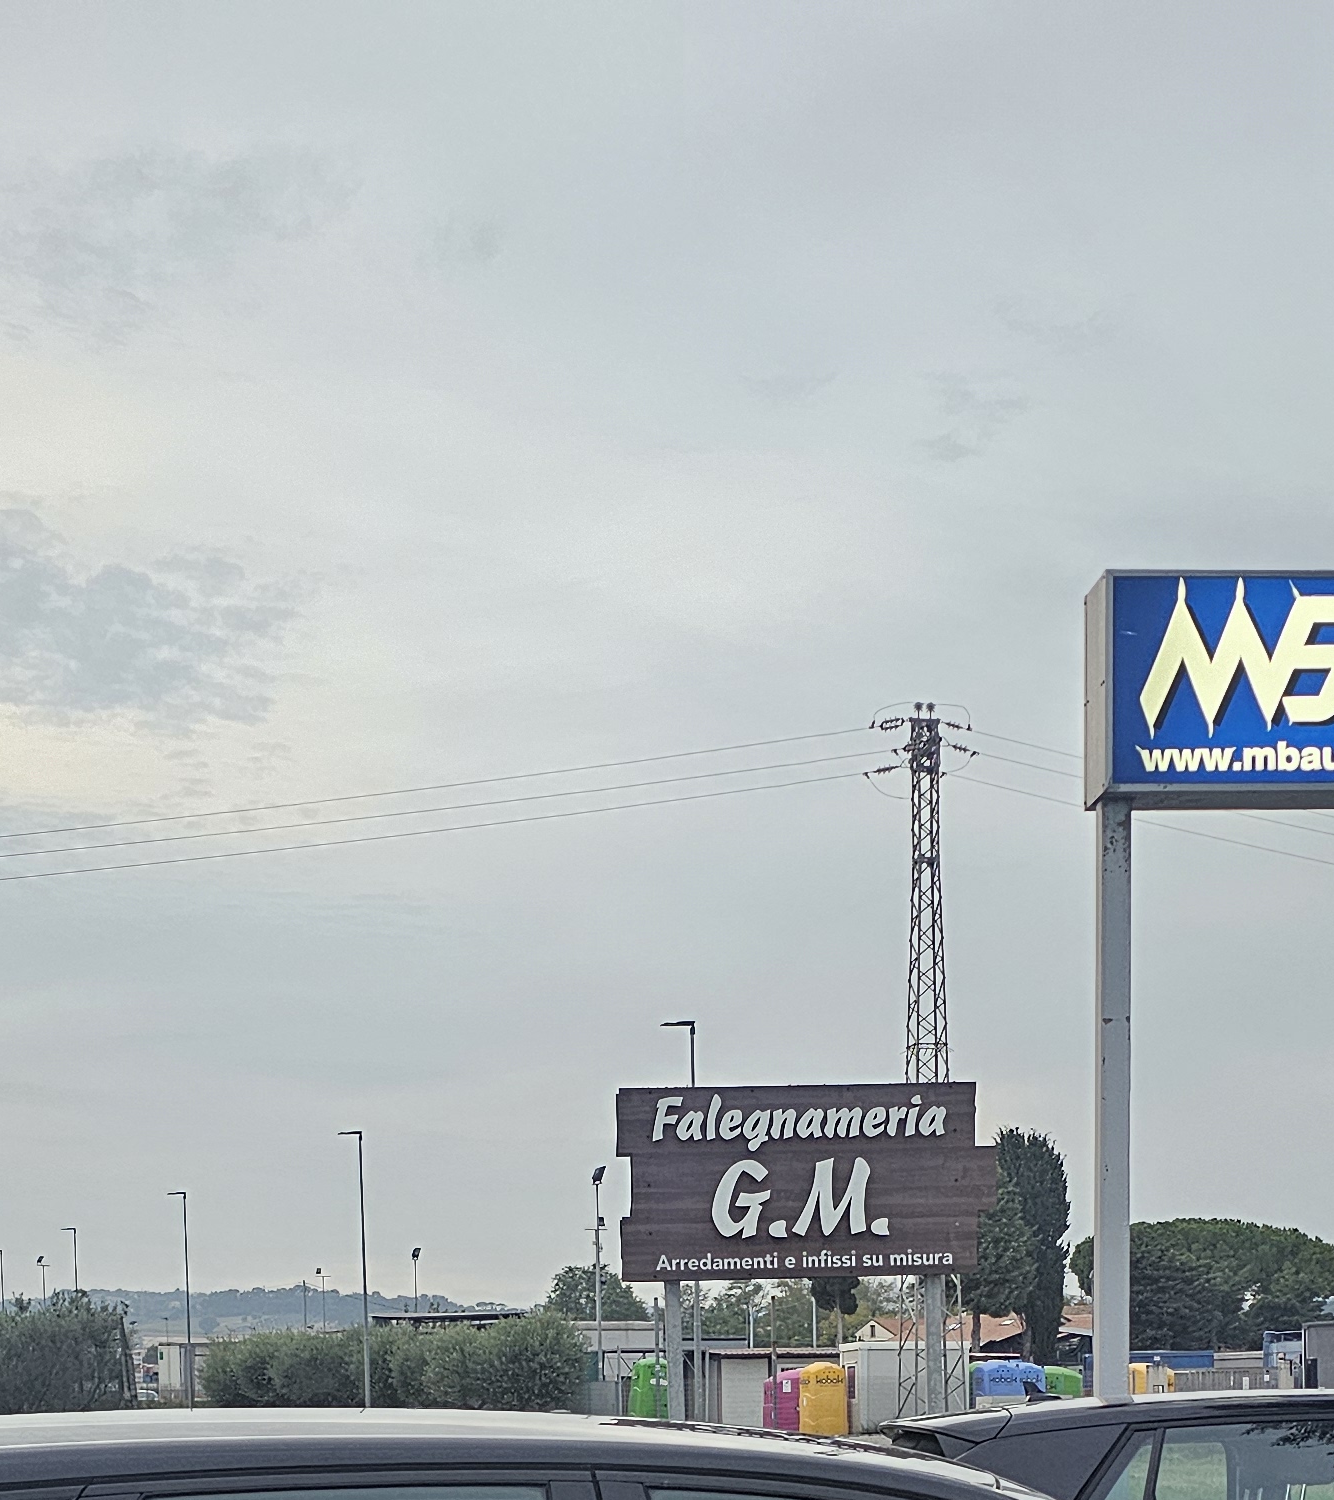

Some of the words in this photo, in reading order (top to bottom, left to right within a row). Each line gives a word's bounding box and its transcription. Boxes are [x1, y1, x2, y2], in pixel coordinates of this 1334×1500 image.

[652, 1094, 947, 1151] Falegnameria
[712, 1156, 890, 1239] G.M.
[656, 1253, 778, 1271] Arredamenti
[785, 1257, 796, 1269] e
[802, 1250, 856, 1268] infissi
[862, 1254, 883, 1267] su
[890, 1249, 953, 1266] misura
